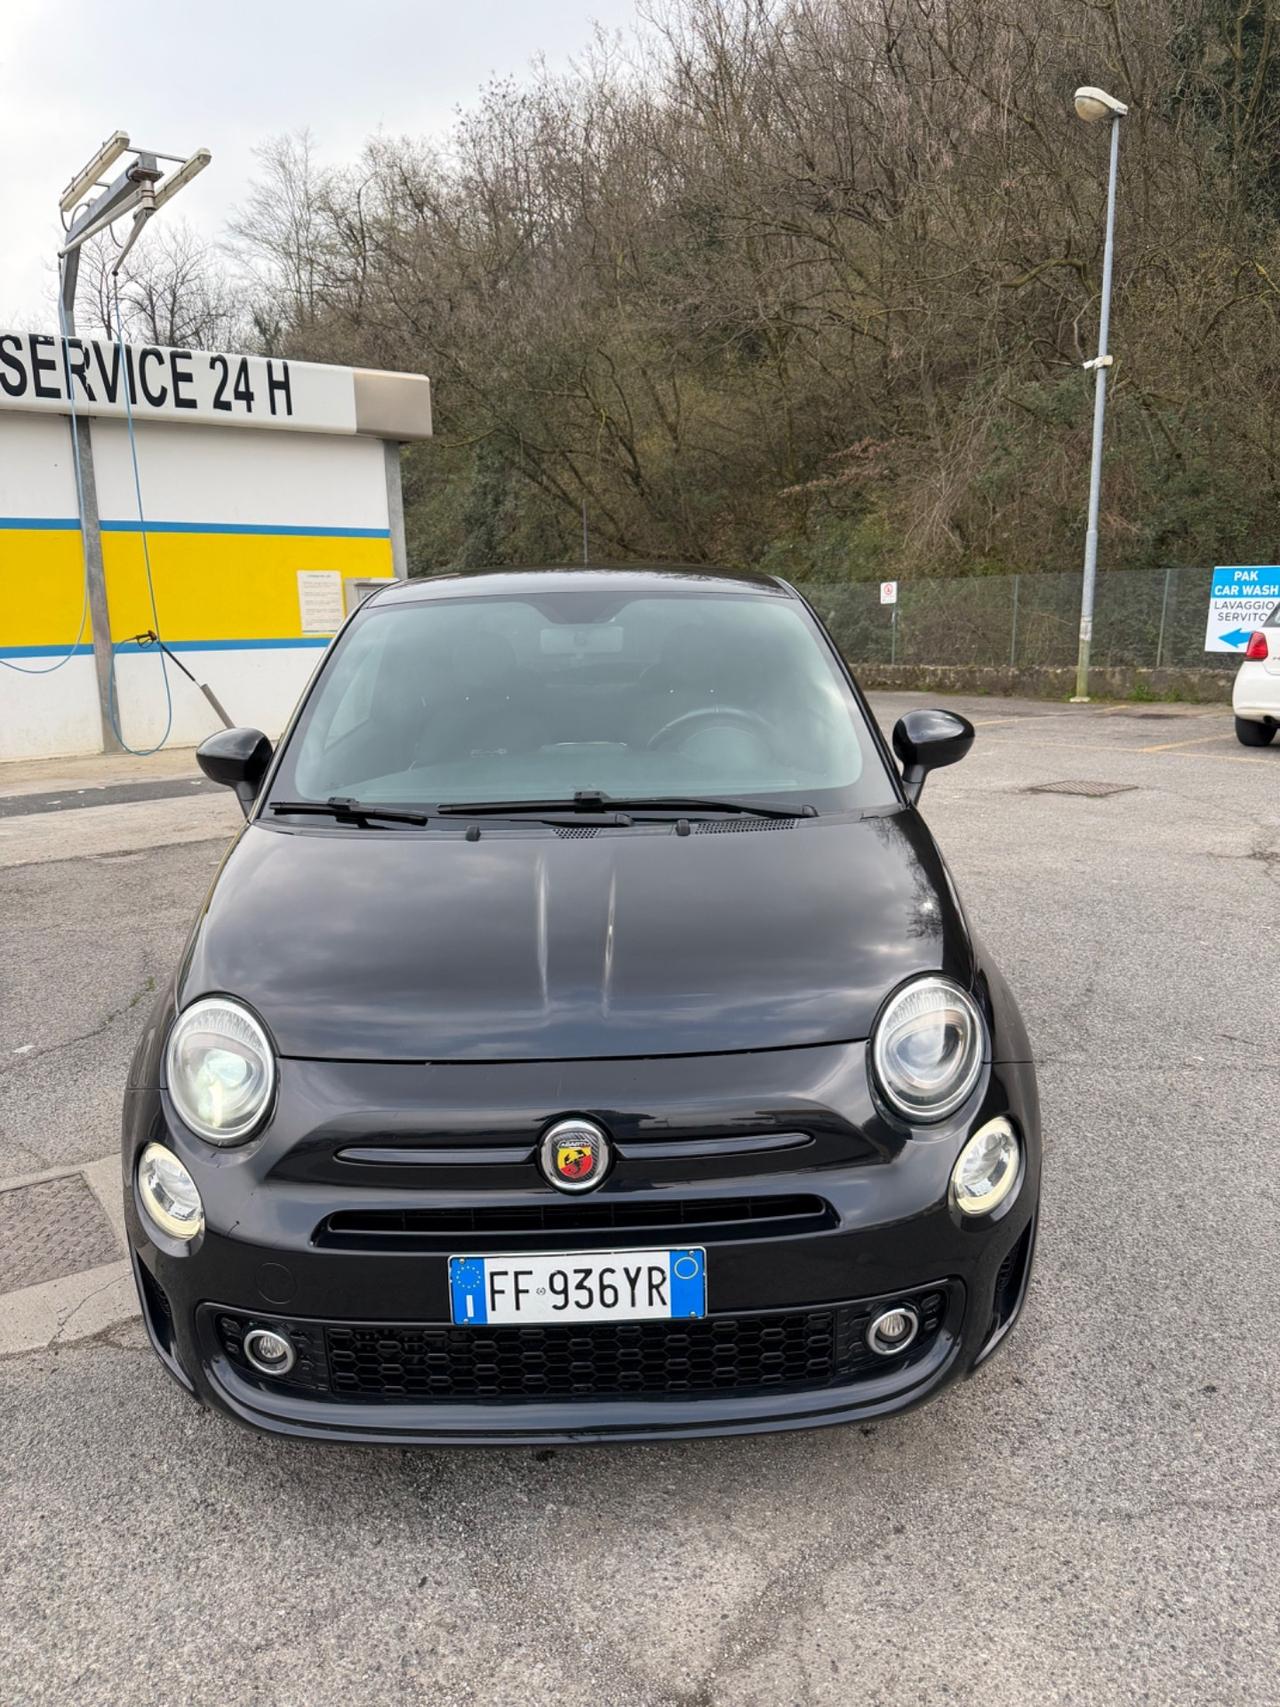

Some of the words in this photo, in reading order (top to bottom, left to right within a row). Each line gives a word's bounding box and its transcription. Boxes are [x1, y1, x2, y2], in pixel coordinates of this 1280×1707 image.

[0, 333, 198, 409] SERVICE
[209, 353, 255, 413] 24
[266, 359, 293, 416] H
[1234, 570, 1259, 581] PAK
[1214, 585, 1240, 595] CAR
[1242, 584, 1279, 595] WASH
[1214, 601, 1275, 610] LAVAGGIO
[489, 1269, 534, 1312] FF
[548, 1265, 668, 1311] 936YR
